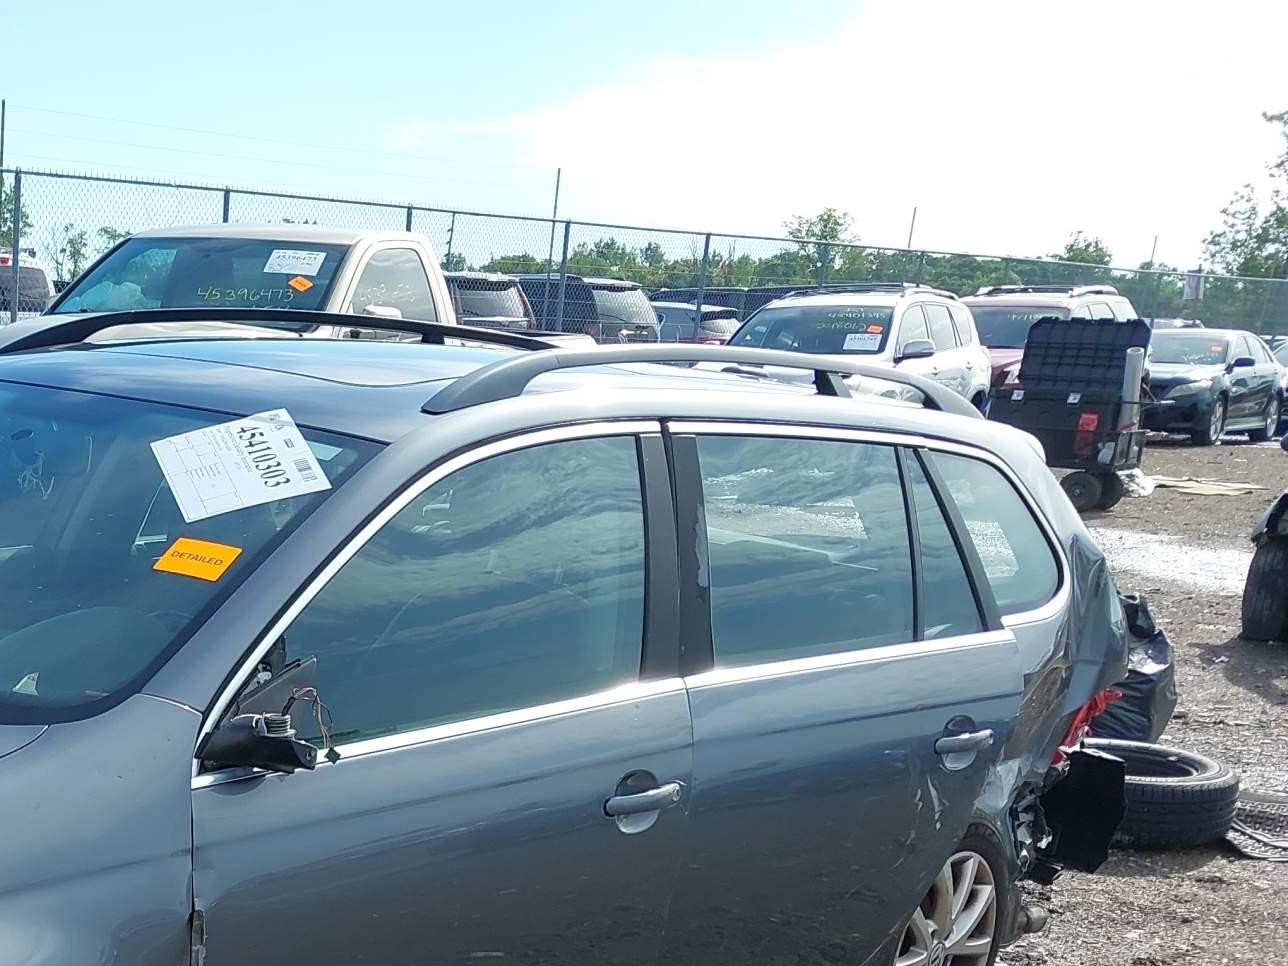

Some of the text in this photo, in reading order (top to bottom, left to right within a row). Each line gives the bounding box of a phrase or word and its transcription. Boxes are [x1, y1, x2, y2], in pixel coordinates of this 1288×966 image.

[197, 286, 294, 303] 45396473
[236, 424, 291, 488] 45410303
[170, 550, 223, 567] DETAILED
